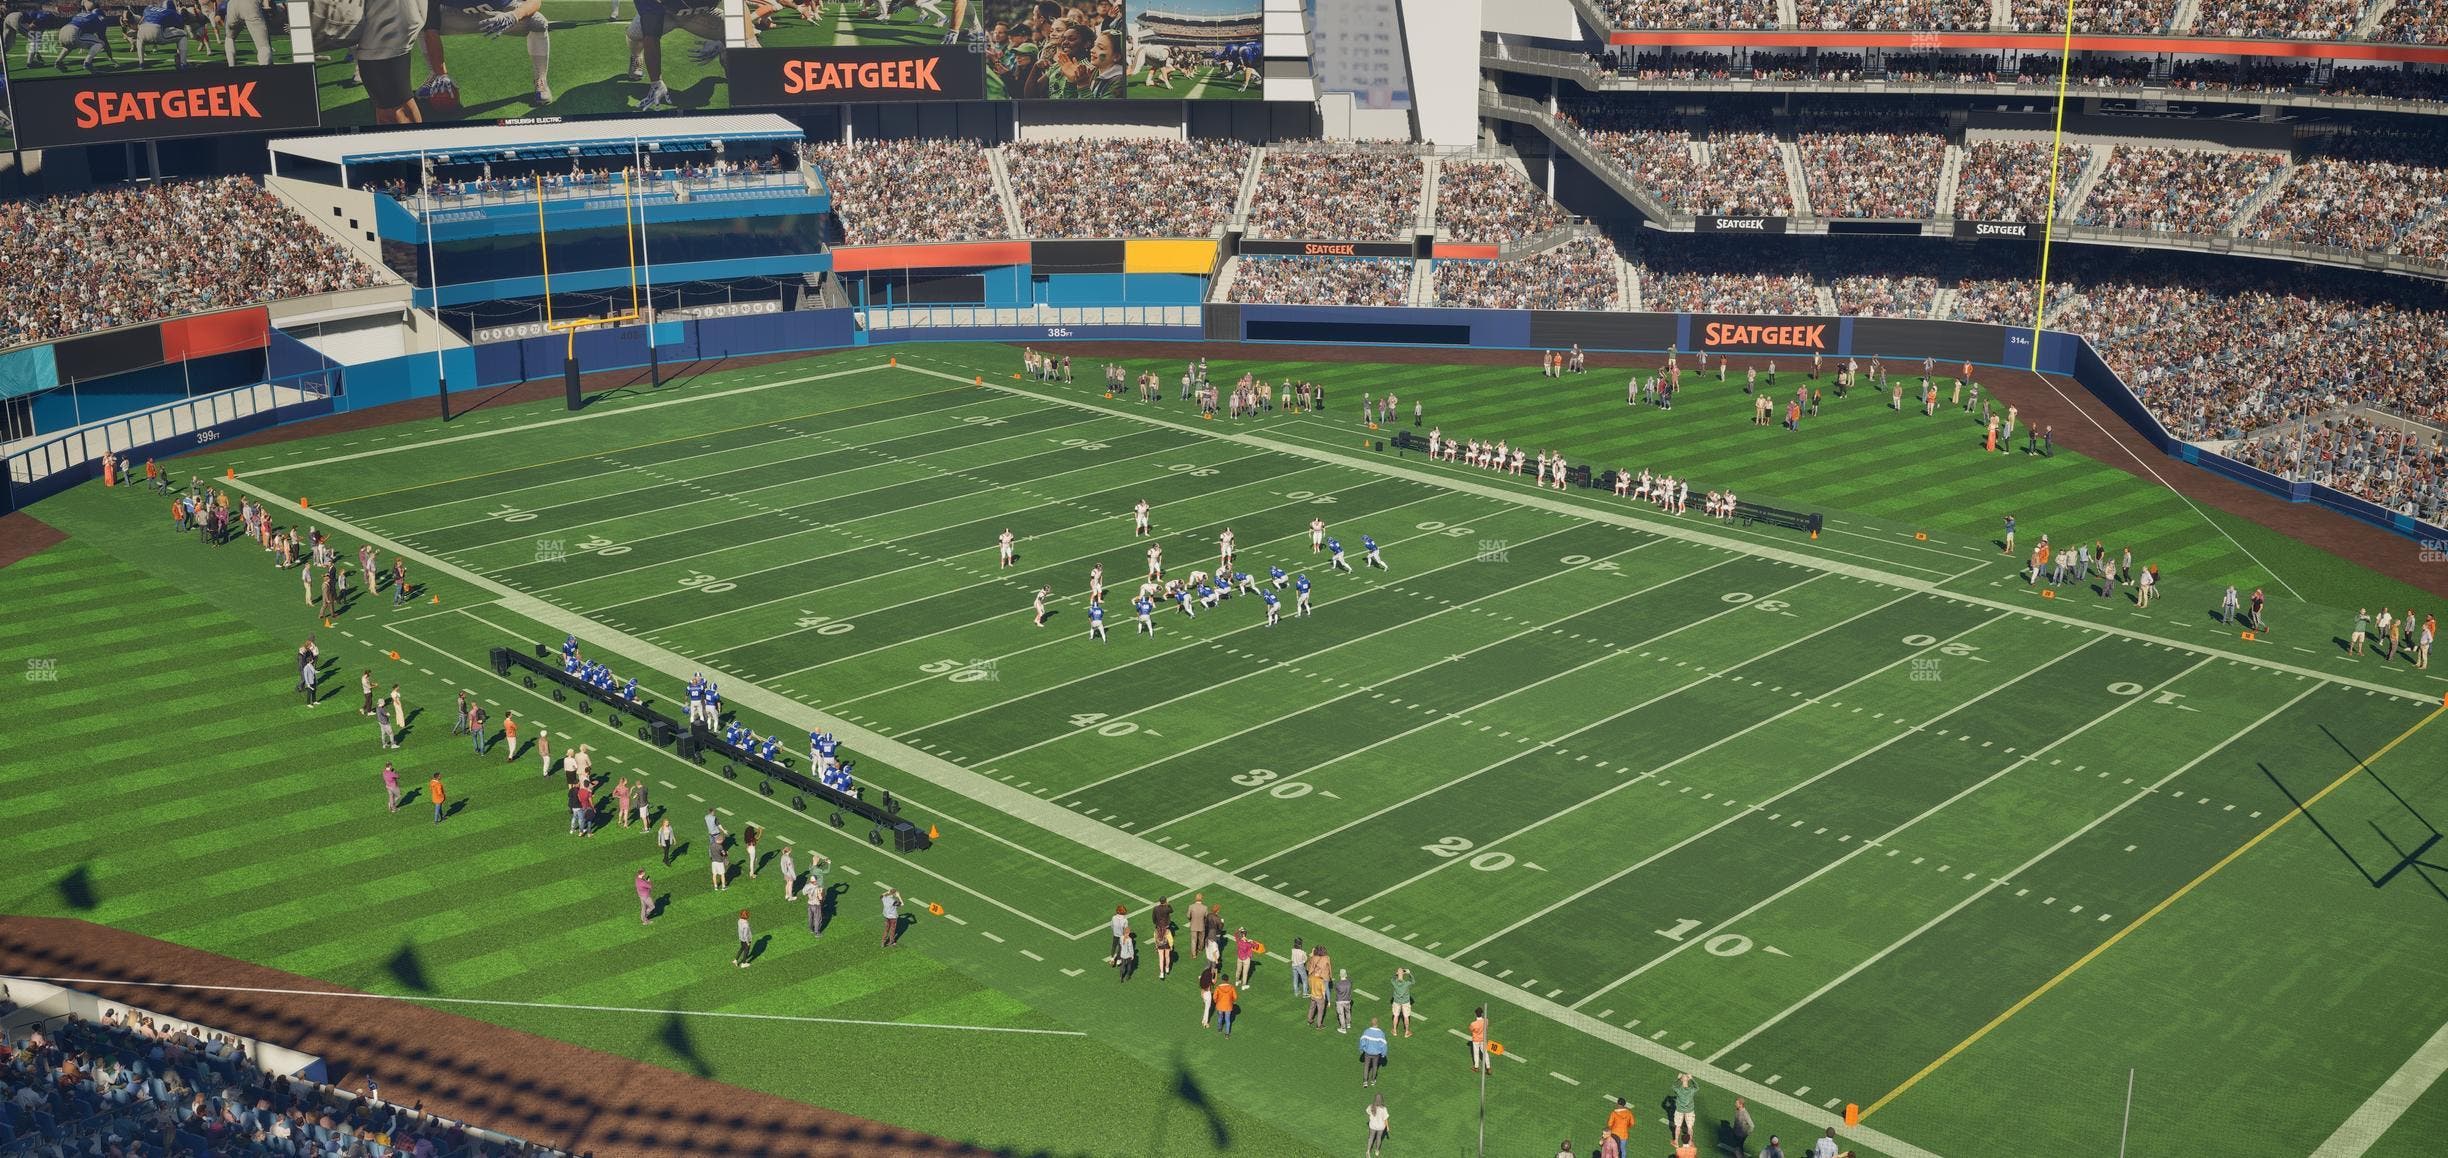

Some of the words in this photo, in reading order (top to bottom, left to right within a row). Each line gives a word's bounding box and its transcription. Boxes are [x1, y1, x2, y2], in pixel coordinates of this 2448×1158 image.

[783, 57, 941, 94] SEATGEEK
[74, 81, 262, 129] SEATGEEK
[1716, 219, 1764, 230] SEATGEEK
[1976, 224, 2026, 236] SEATGEEK
[1305, 244, 1355, 255] SEATGEEK
[1705, 322, 1826, 349] SEATGEEK
[488, 508, 538, 522] 10
[575, 539, 632, 555] 20
[678, 575, 737, 593] 30
[1721, 592, 1790, 611] 30
[794, 617, 855, 635] 40
[1902, 634, 1980, 656] 20
[920, 659, 988, 682] 50
[2107, 682, 2186, 704] 10
[1068, 712, 1139, 736] 40
[1231, 768, 1313, 799] 30
[1421, 836, 1515, 871] 20
[1654, 918, 1753, 956] 10
